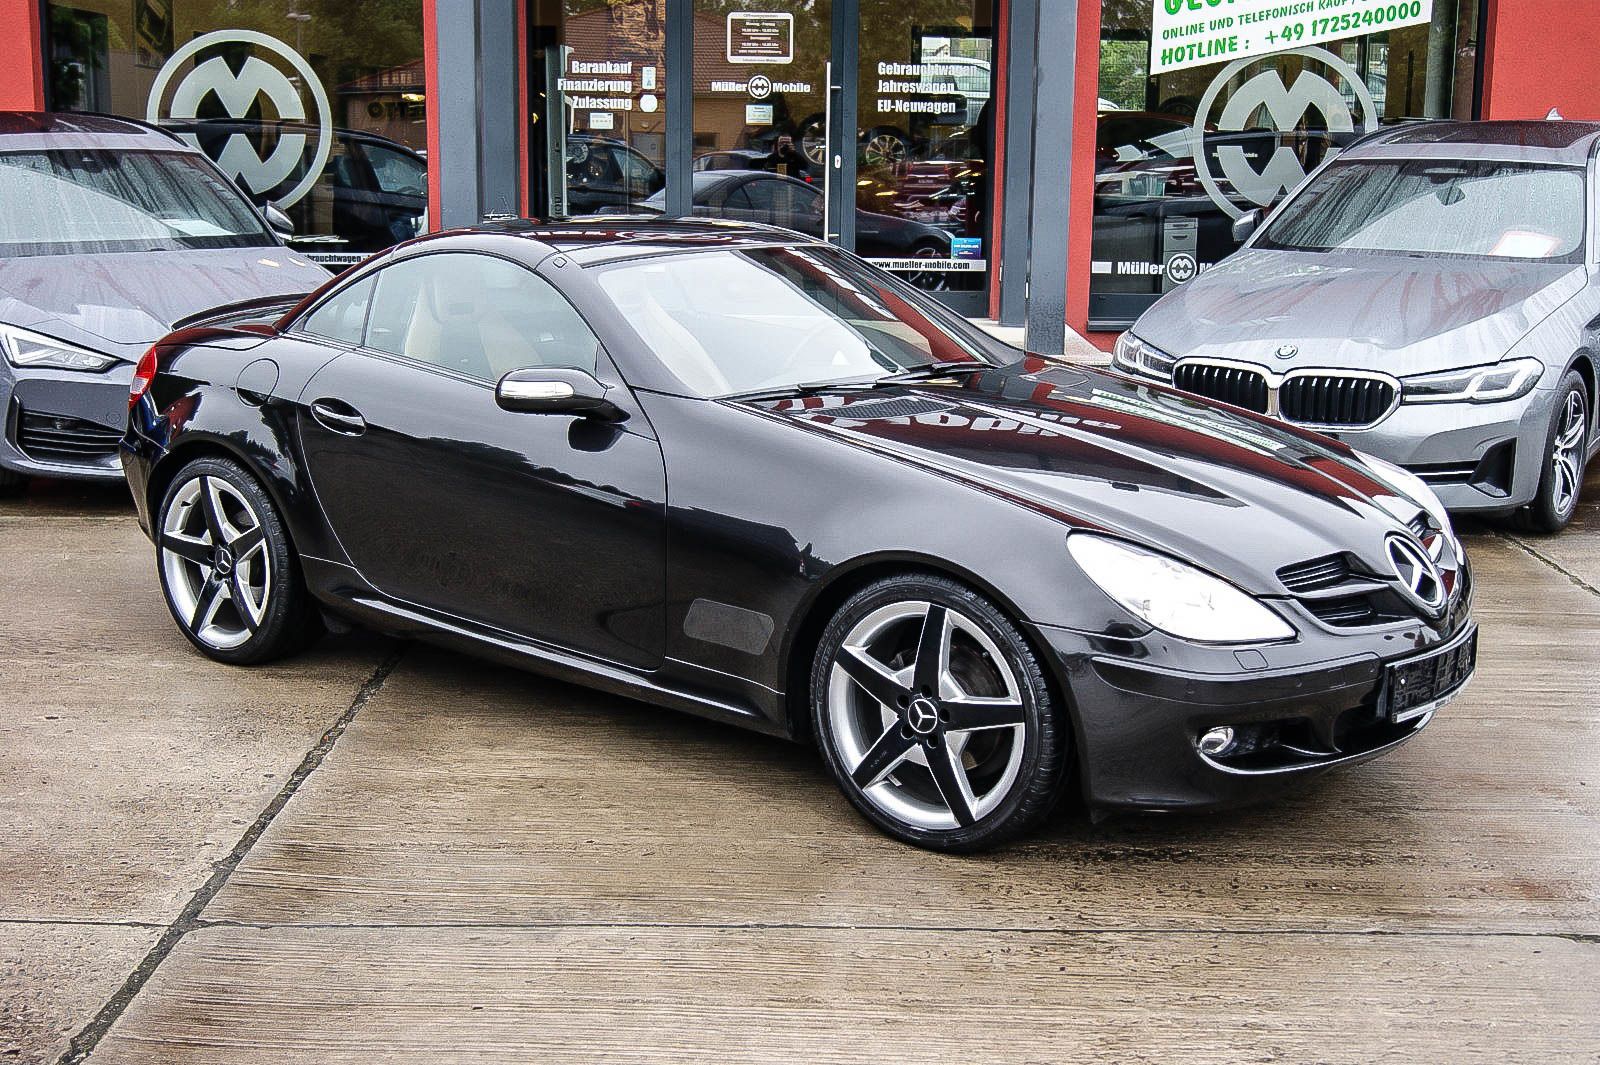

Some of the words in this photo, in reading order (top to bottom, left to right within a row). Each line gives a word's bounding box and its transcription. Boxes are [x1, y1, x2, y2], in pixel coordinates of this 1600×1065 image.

[1162, 22, 1205, 40] ONLINE
[1209, 16, 1234, 31] UND
[1237, 1, 1314, 25] TELEFONISCH
[1160, 35, 1238, 66] HOTLINE
[1265, 22, 1304, 44] +49
[1311, 1, 1421, 37] 1725240000
[571, 61, 632, 74] Barankauf
[877, 62, 977, 76] Gebrauchtwagen
[557, 78, 632, 94] Finanzierung
[711, 81, 748, 92] Müller
[772, 82, 811, 93] Mobile
[877, 80, 955, 93] Jahreswagen
[573, 96, 632, 111] Zulassung
[877, 99, 956, 114] EU-Neuwagen
[305, 253, 361, 263] brauchtwagen
[1117, 261, 1165, 275] Müller
